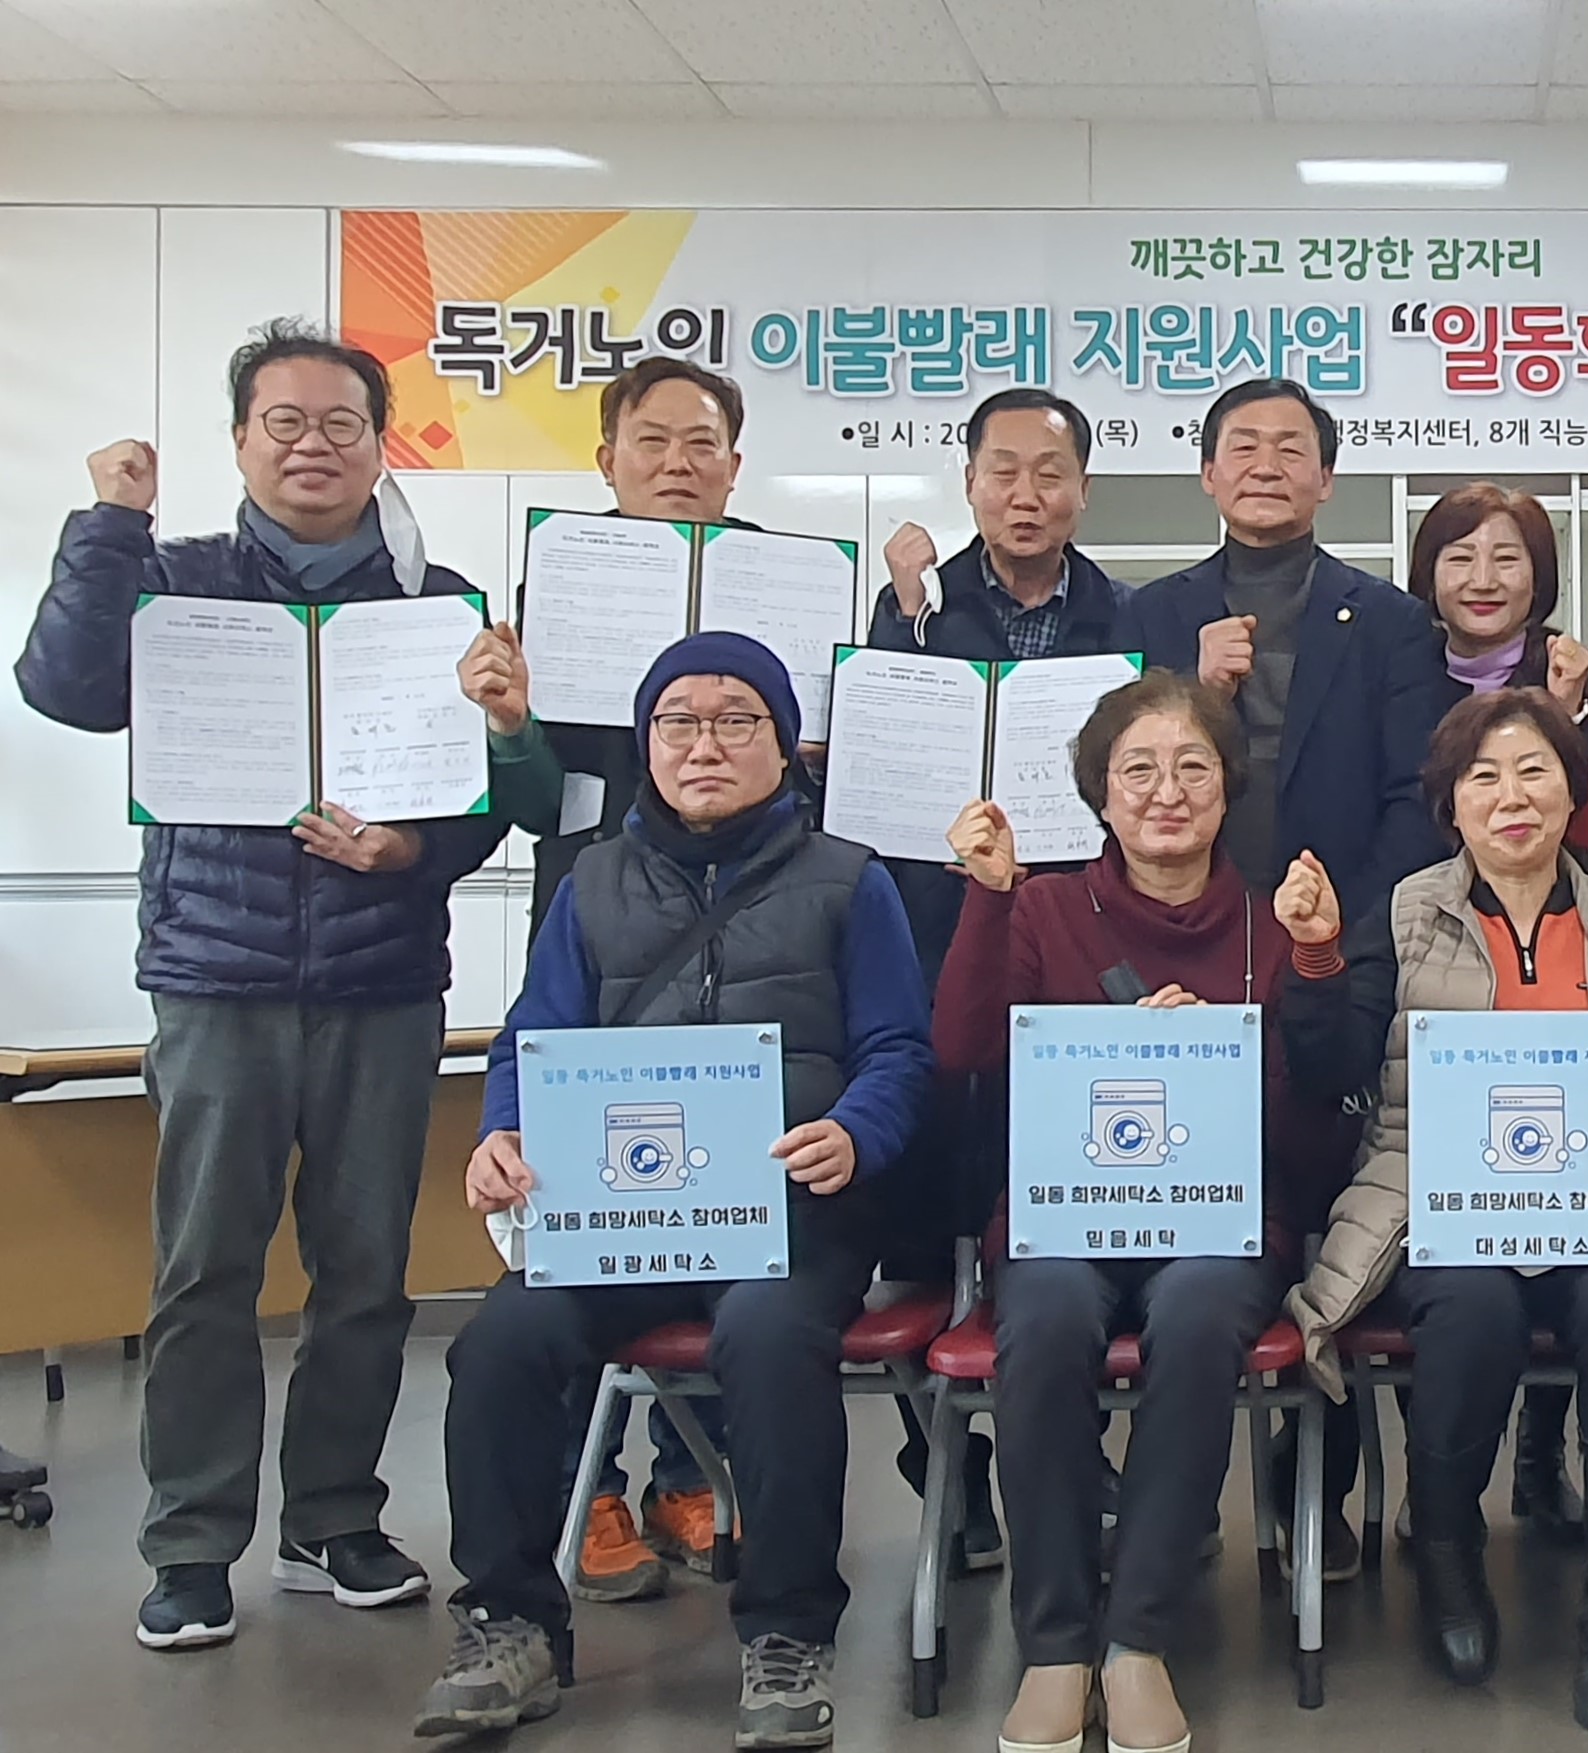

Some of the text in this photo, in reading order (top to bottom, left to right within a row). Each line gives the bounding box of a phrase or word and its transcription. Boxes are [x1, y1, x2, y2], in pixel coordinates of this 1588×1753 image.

[1131, 237, 1542, 279] 깨끗하고 건강한 잠자리
[751, 306, 1046, 393] 이불빨래
[1073, 305, 1361, 391] 지원사업
[940, 422, 968, 446] 20
[1096, 419, 1139, 447] (목)
[1489, 419, 1530, 446] 8개
[1187, 1043, 1241, 1059] 지원사업
[704, 1063, 761, 1080] 지원사업
[1028, 1184, 1244, 1204] 일동 희망세탁소 참여업체
[1428, 1193, 1463, 1211] 일동
[1470, 1191, 1563, 1211] 희망세탁소
[544, 1206, 768, 1232] 일동 희망세탁소 참여업체
